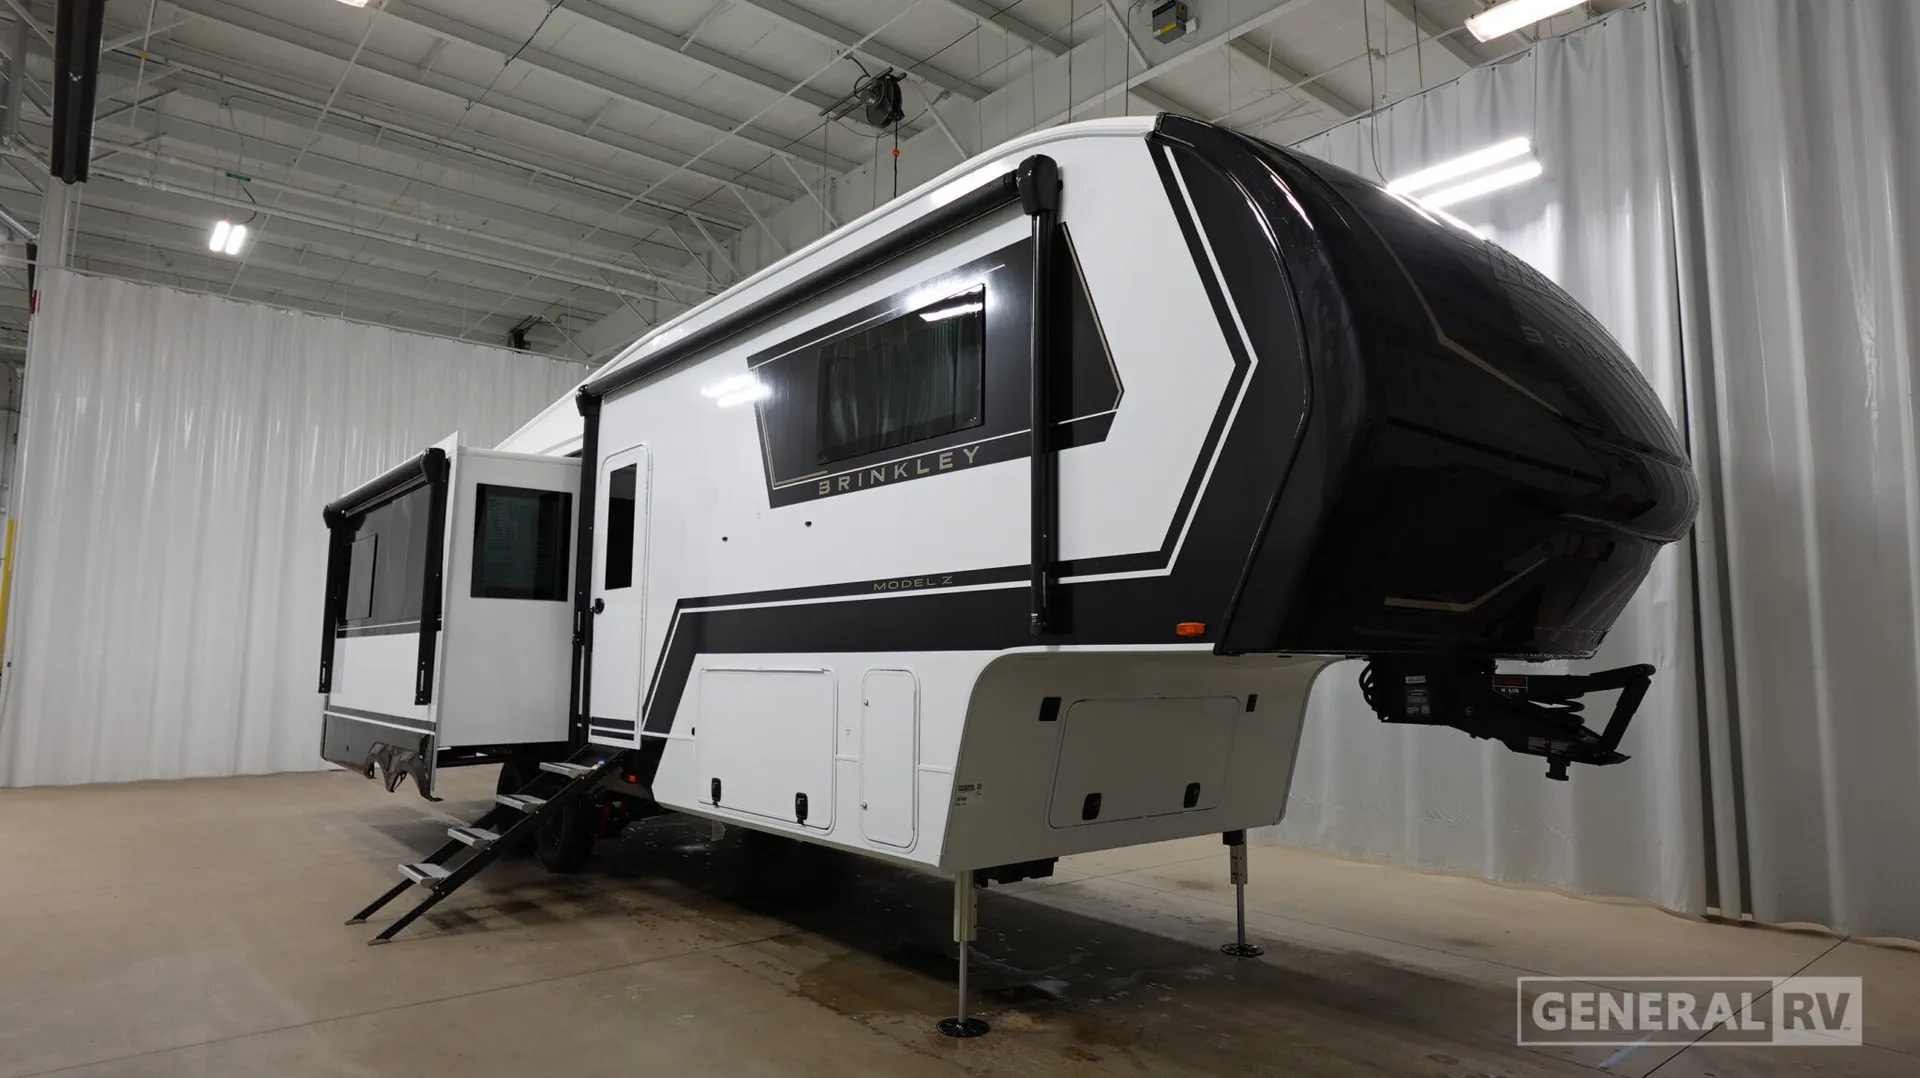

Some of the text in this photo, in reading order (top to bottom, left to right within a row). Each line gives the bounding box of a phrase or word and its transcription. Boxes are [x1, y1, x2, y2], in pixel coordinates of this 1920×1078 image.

[818, 446, 980, 495] BRINKLEY
[873, 575, 953, 591] MODEL Z
